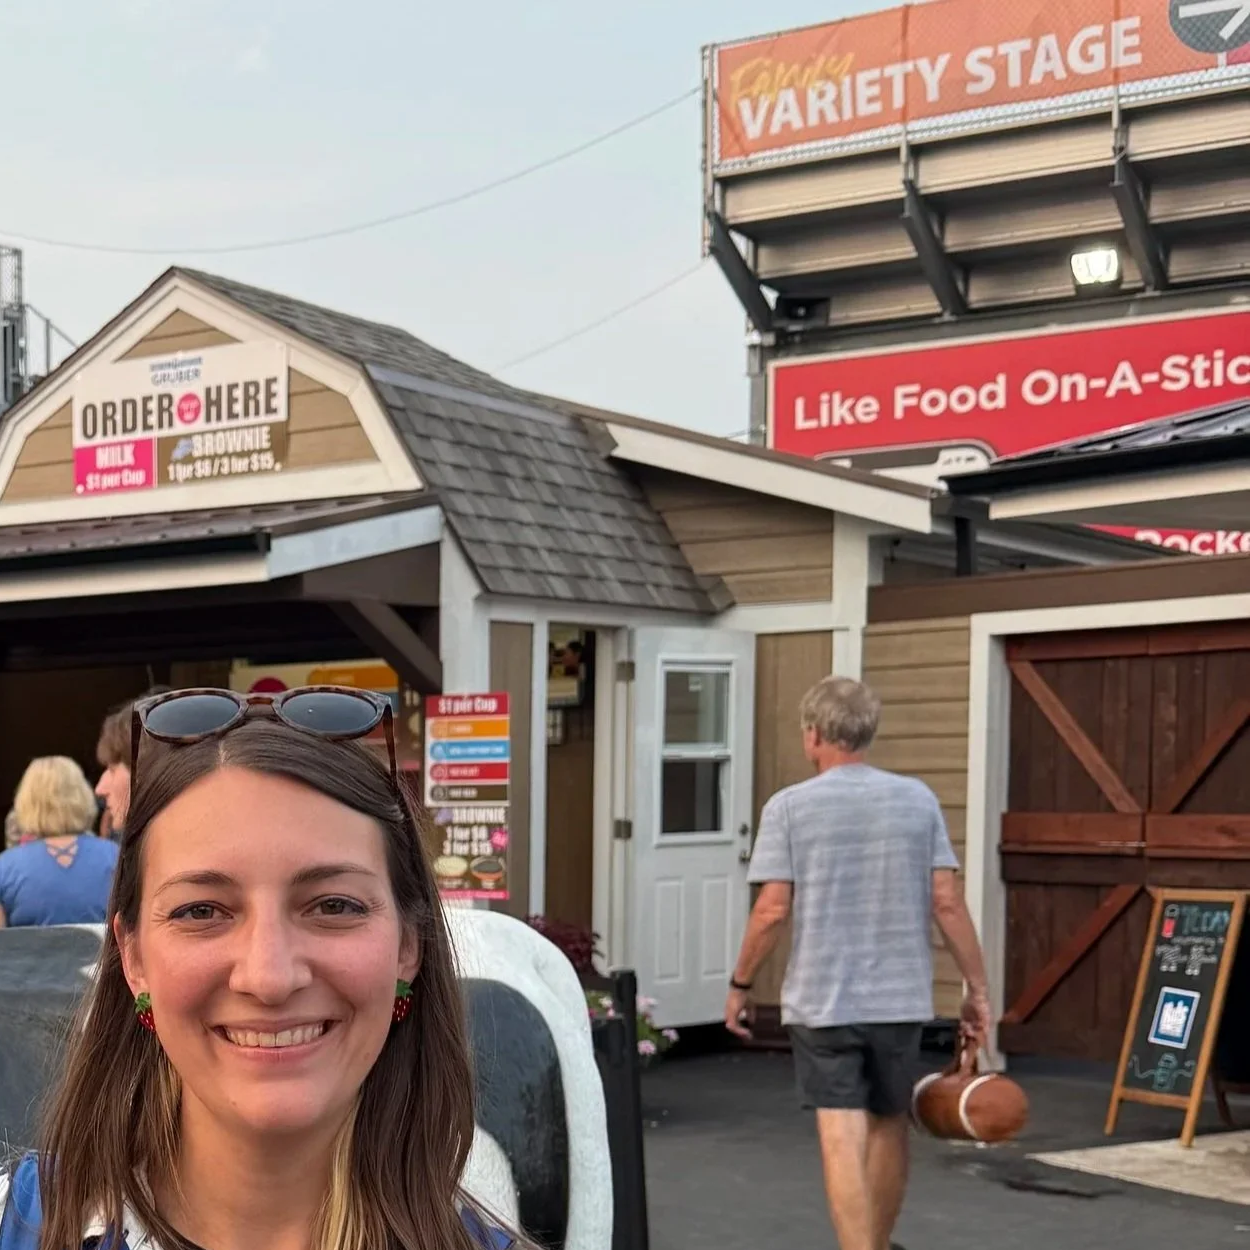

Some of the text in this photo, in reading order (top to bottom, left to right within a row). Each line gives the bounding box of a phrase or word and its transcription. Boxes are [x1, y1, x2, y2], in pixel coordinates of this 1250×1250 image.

[737, 15, 1143, 140] VARIETY STAGE
[81, 392, 174, 439] ORDER
[205, 377, 278, 423] HERE
[794, 392, 879, 430] Like
[893, 373, 1007, 419] Food
